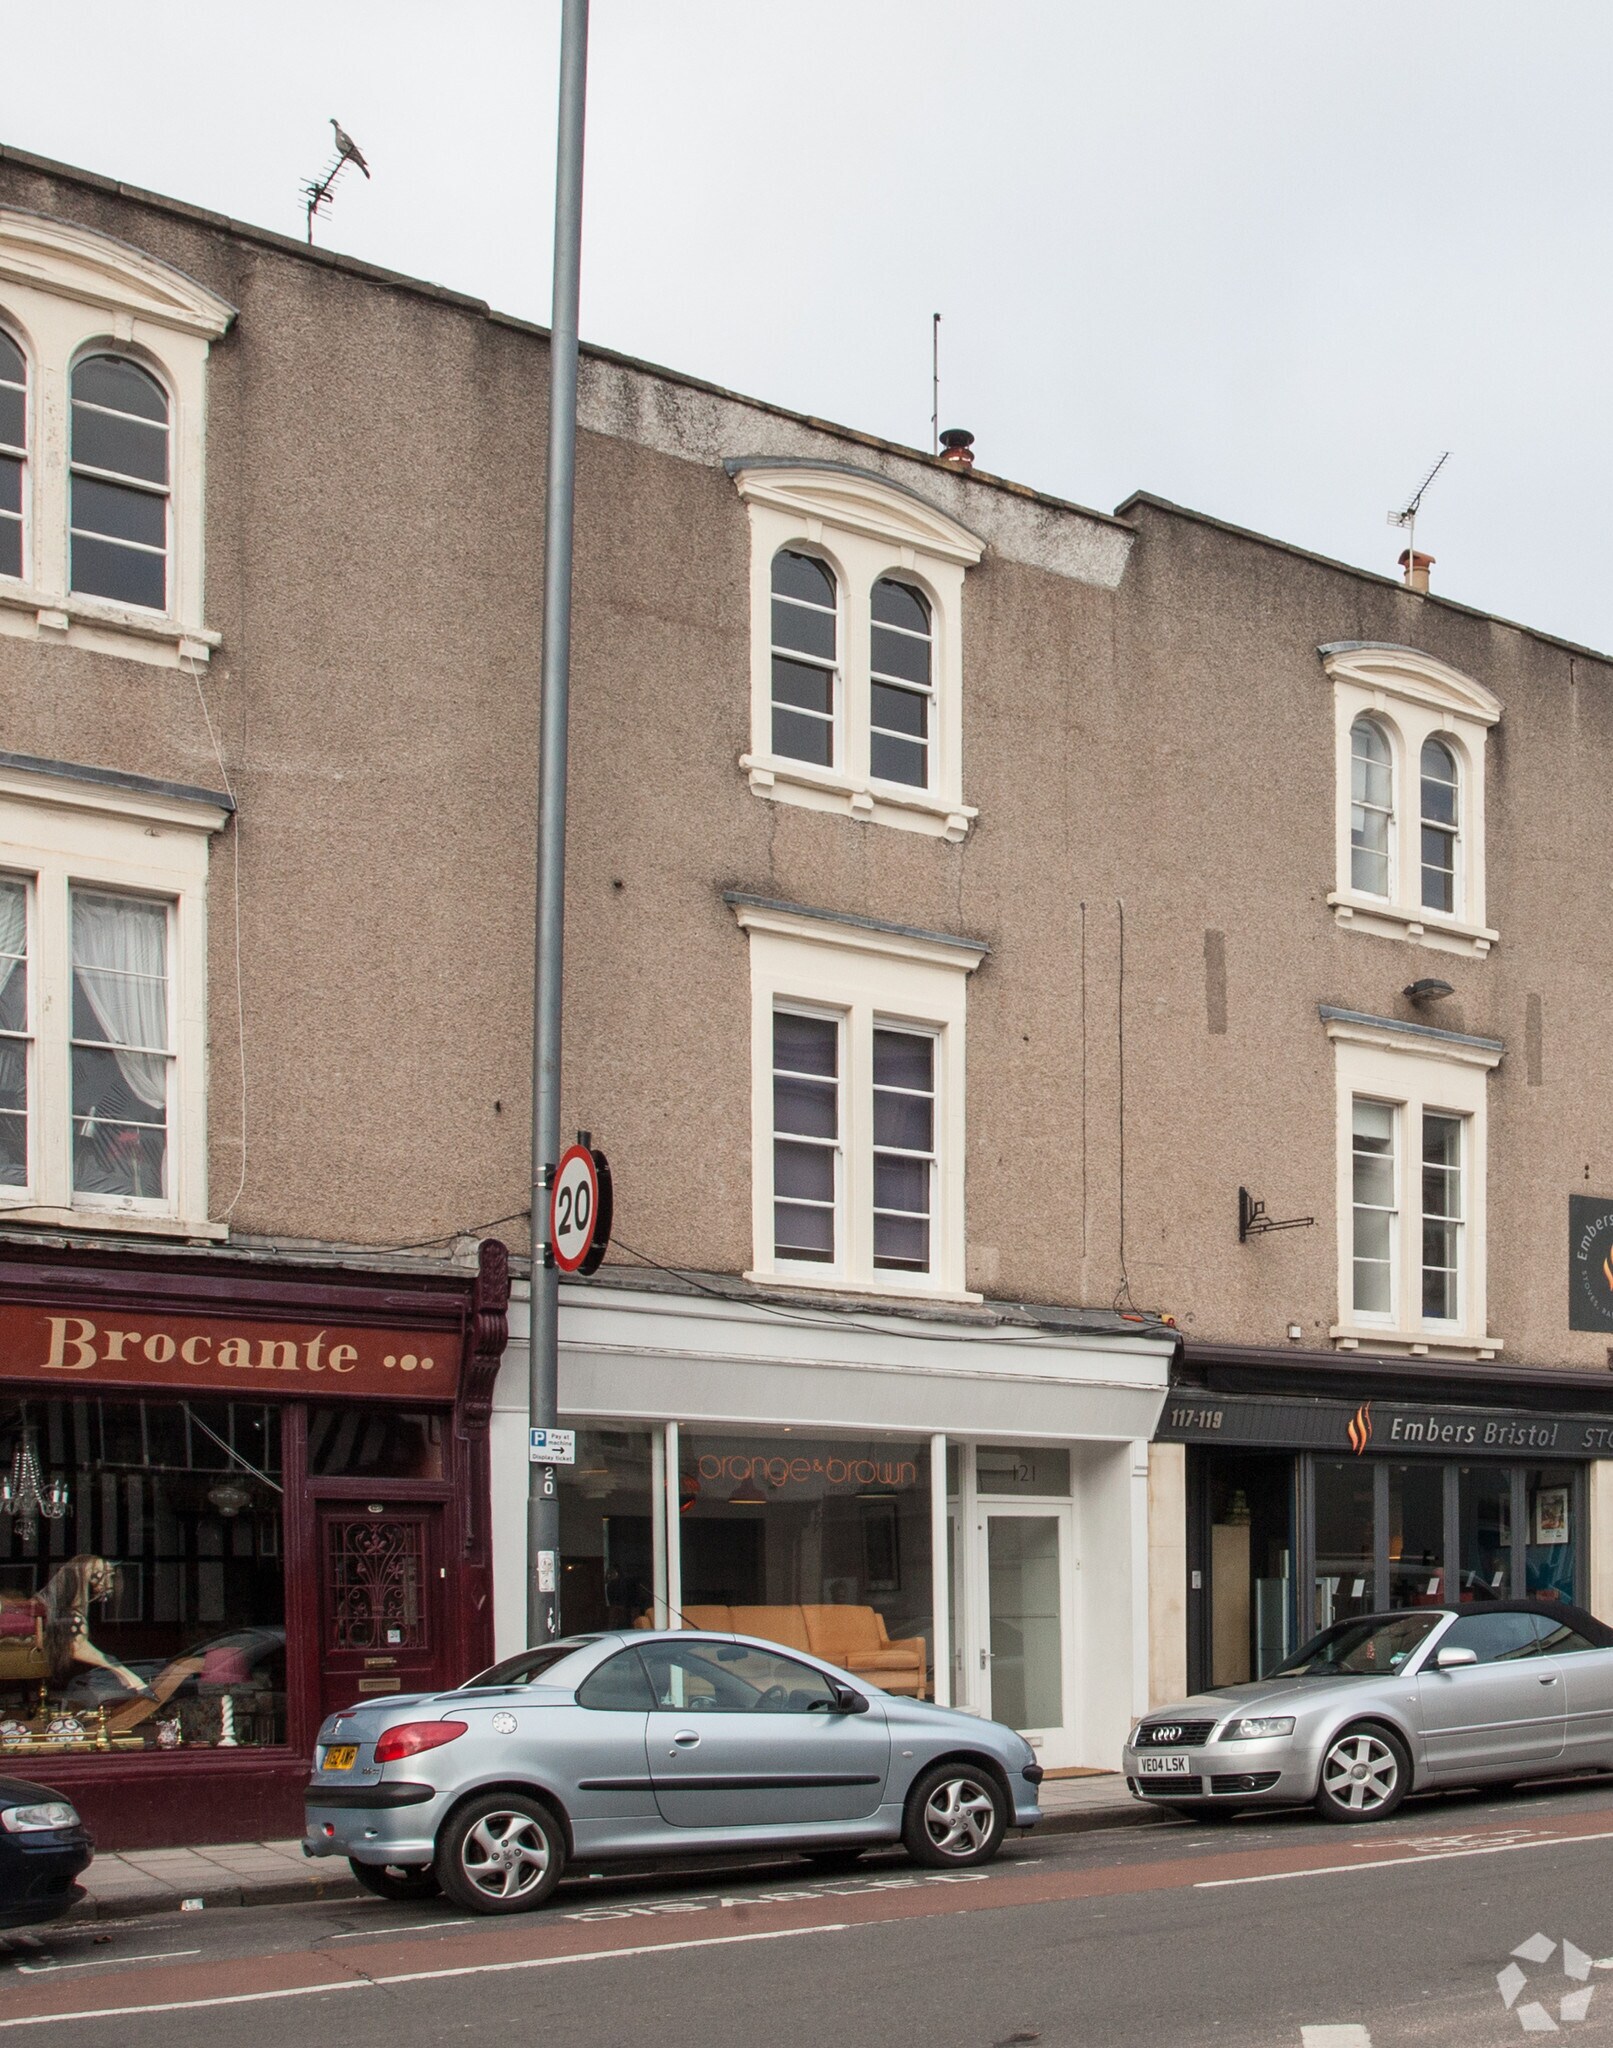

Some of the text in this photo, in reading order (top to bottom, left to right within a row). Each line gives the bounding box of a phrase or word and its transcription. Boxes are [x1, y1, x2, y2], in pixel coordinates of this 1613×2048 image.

[558, 1180, 590, 1236] 20
[40, 1316, 358, 1372] Brocante
[1171, 1408, 1223, 1429] 117-119
[534, 1431, 545, 1445] P
[1390, 1417, 1476, 1443] Embers
[1483, 1421, 1559, 1446] Bristol
[1013, 1464, 1035, 1481] 121
[1141, 1758, 1185, 1772] VE04 LSK
[563, 1873, 989, 1922] DISABLED
